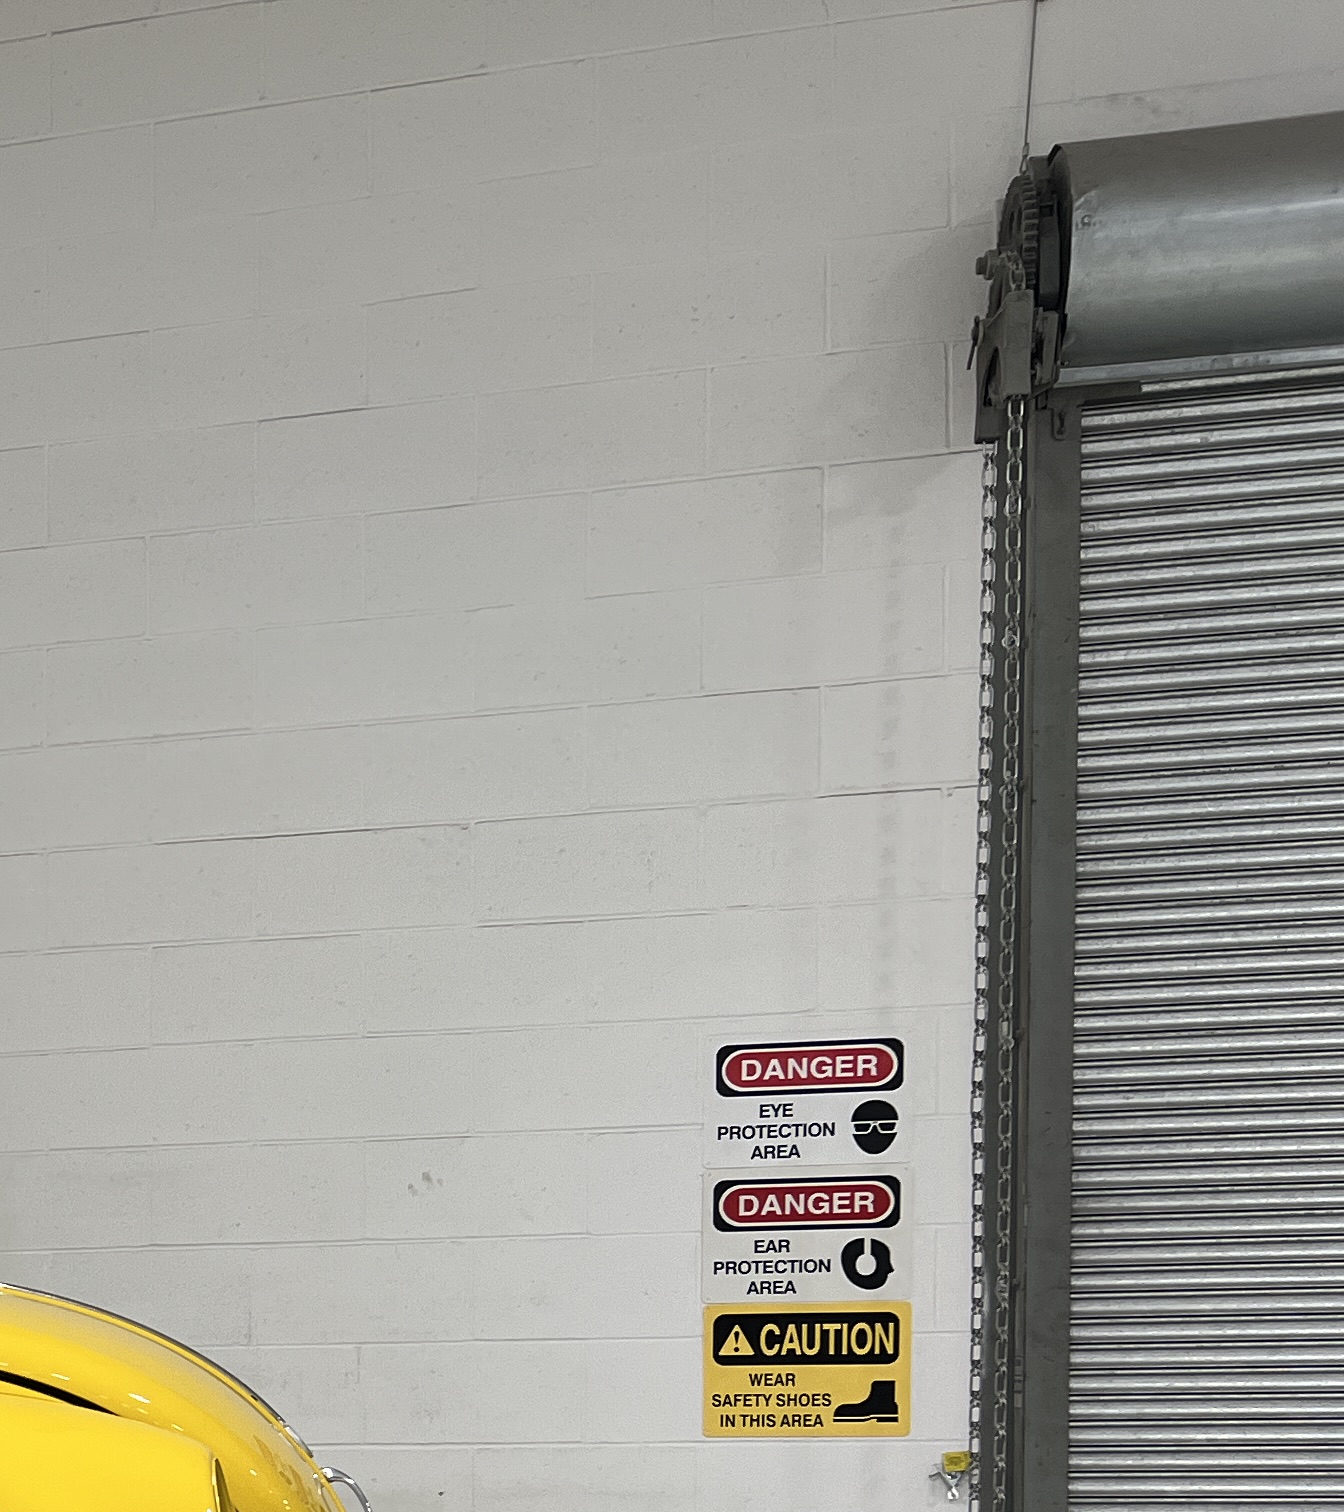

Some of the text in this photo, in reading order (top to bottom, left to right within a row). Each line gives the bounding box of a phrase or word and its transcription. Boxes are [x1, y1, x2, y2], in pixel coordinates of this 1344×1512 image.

[741, 1055, 878, 1081] DANGER
[759, 1103, 794, 1118] EYE
[717, 1122, 836, 1140] PROTECTION
[751, 1144, 801, 1160] AREA
[738, 1192, 875, 1216] DANGER
[754, 1239, 790, 1254] EAR
[713, 1259, 831, 1275] PROTECTION
[746, 1281, 797, 1295] AREA
[760, 1323, 894, 1356] CAUTION
[749, 1373, 796, 1387] WEAR
[712, 1393, 832, 1407] SAFETY SHOES
[720, 1414, 824, 1427] IN THIS AREA
